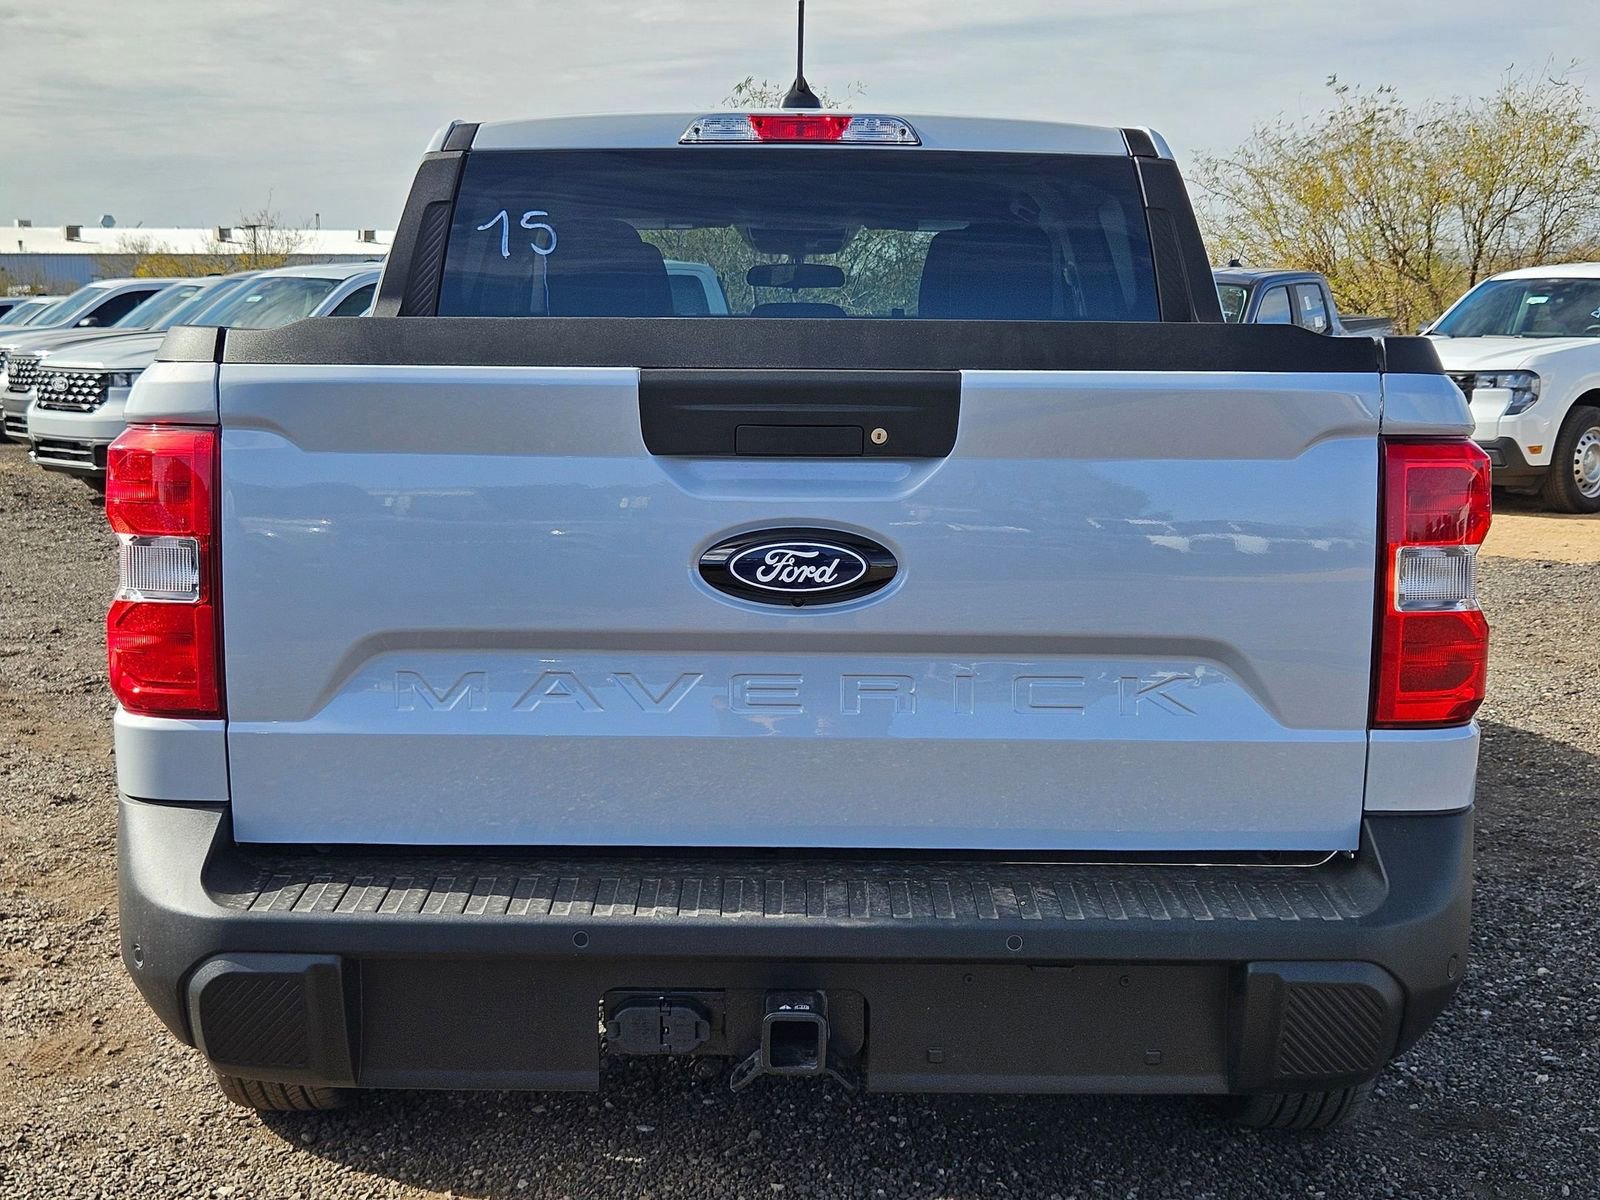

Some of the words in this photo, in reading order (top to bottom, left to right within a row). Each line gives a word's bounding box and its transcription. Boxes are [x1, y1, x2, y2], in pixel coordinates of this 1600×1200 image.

[477, 209, 558, 259] 15
[756, 549, 841, 583] Ford
[395, 670, 1199, 716] MAVERICK
